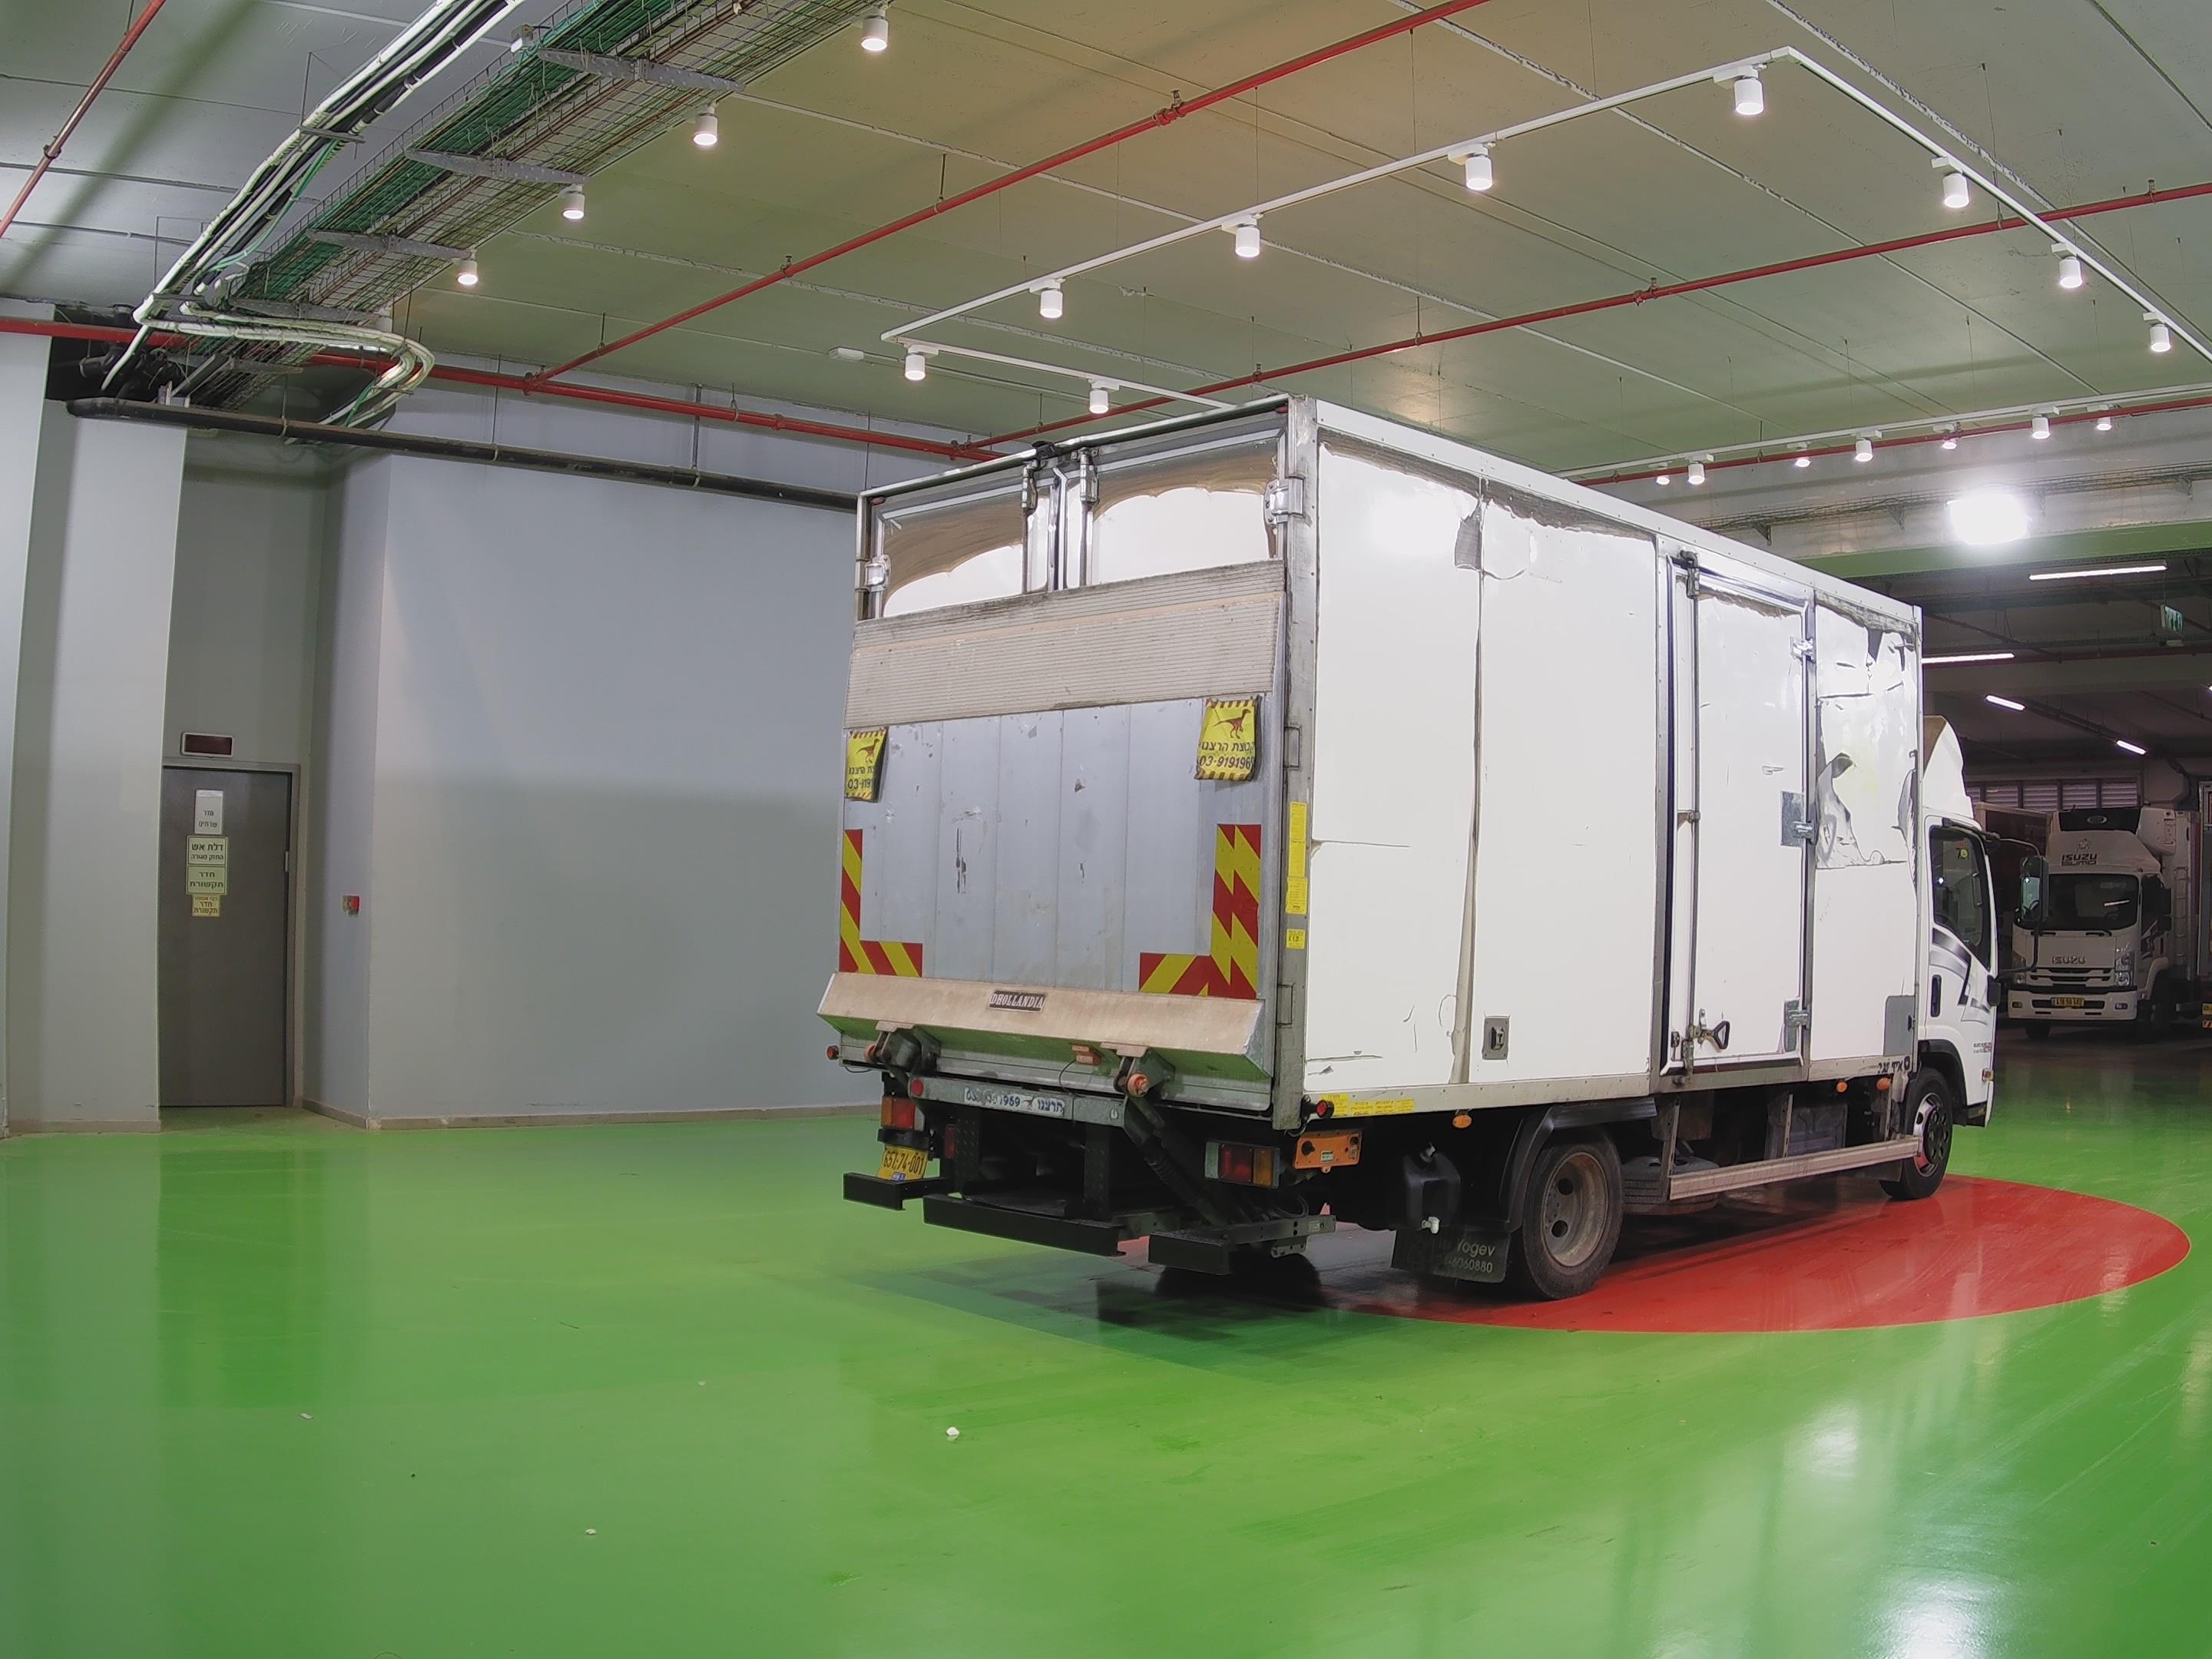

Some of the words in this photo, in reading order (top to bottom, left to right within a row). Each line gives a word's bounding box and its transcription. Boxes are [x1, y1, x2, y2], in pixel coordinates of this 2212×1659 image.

[207, 843, 224, 851] דלת
[190, 881, 224, 889] תקשורת
[2051, 956, 2086, 965] ISUZU
[988, 993, 1045, 1008] DHOLLANDIA
